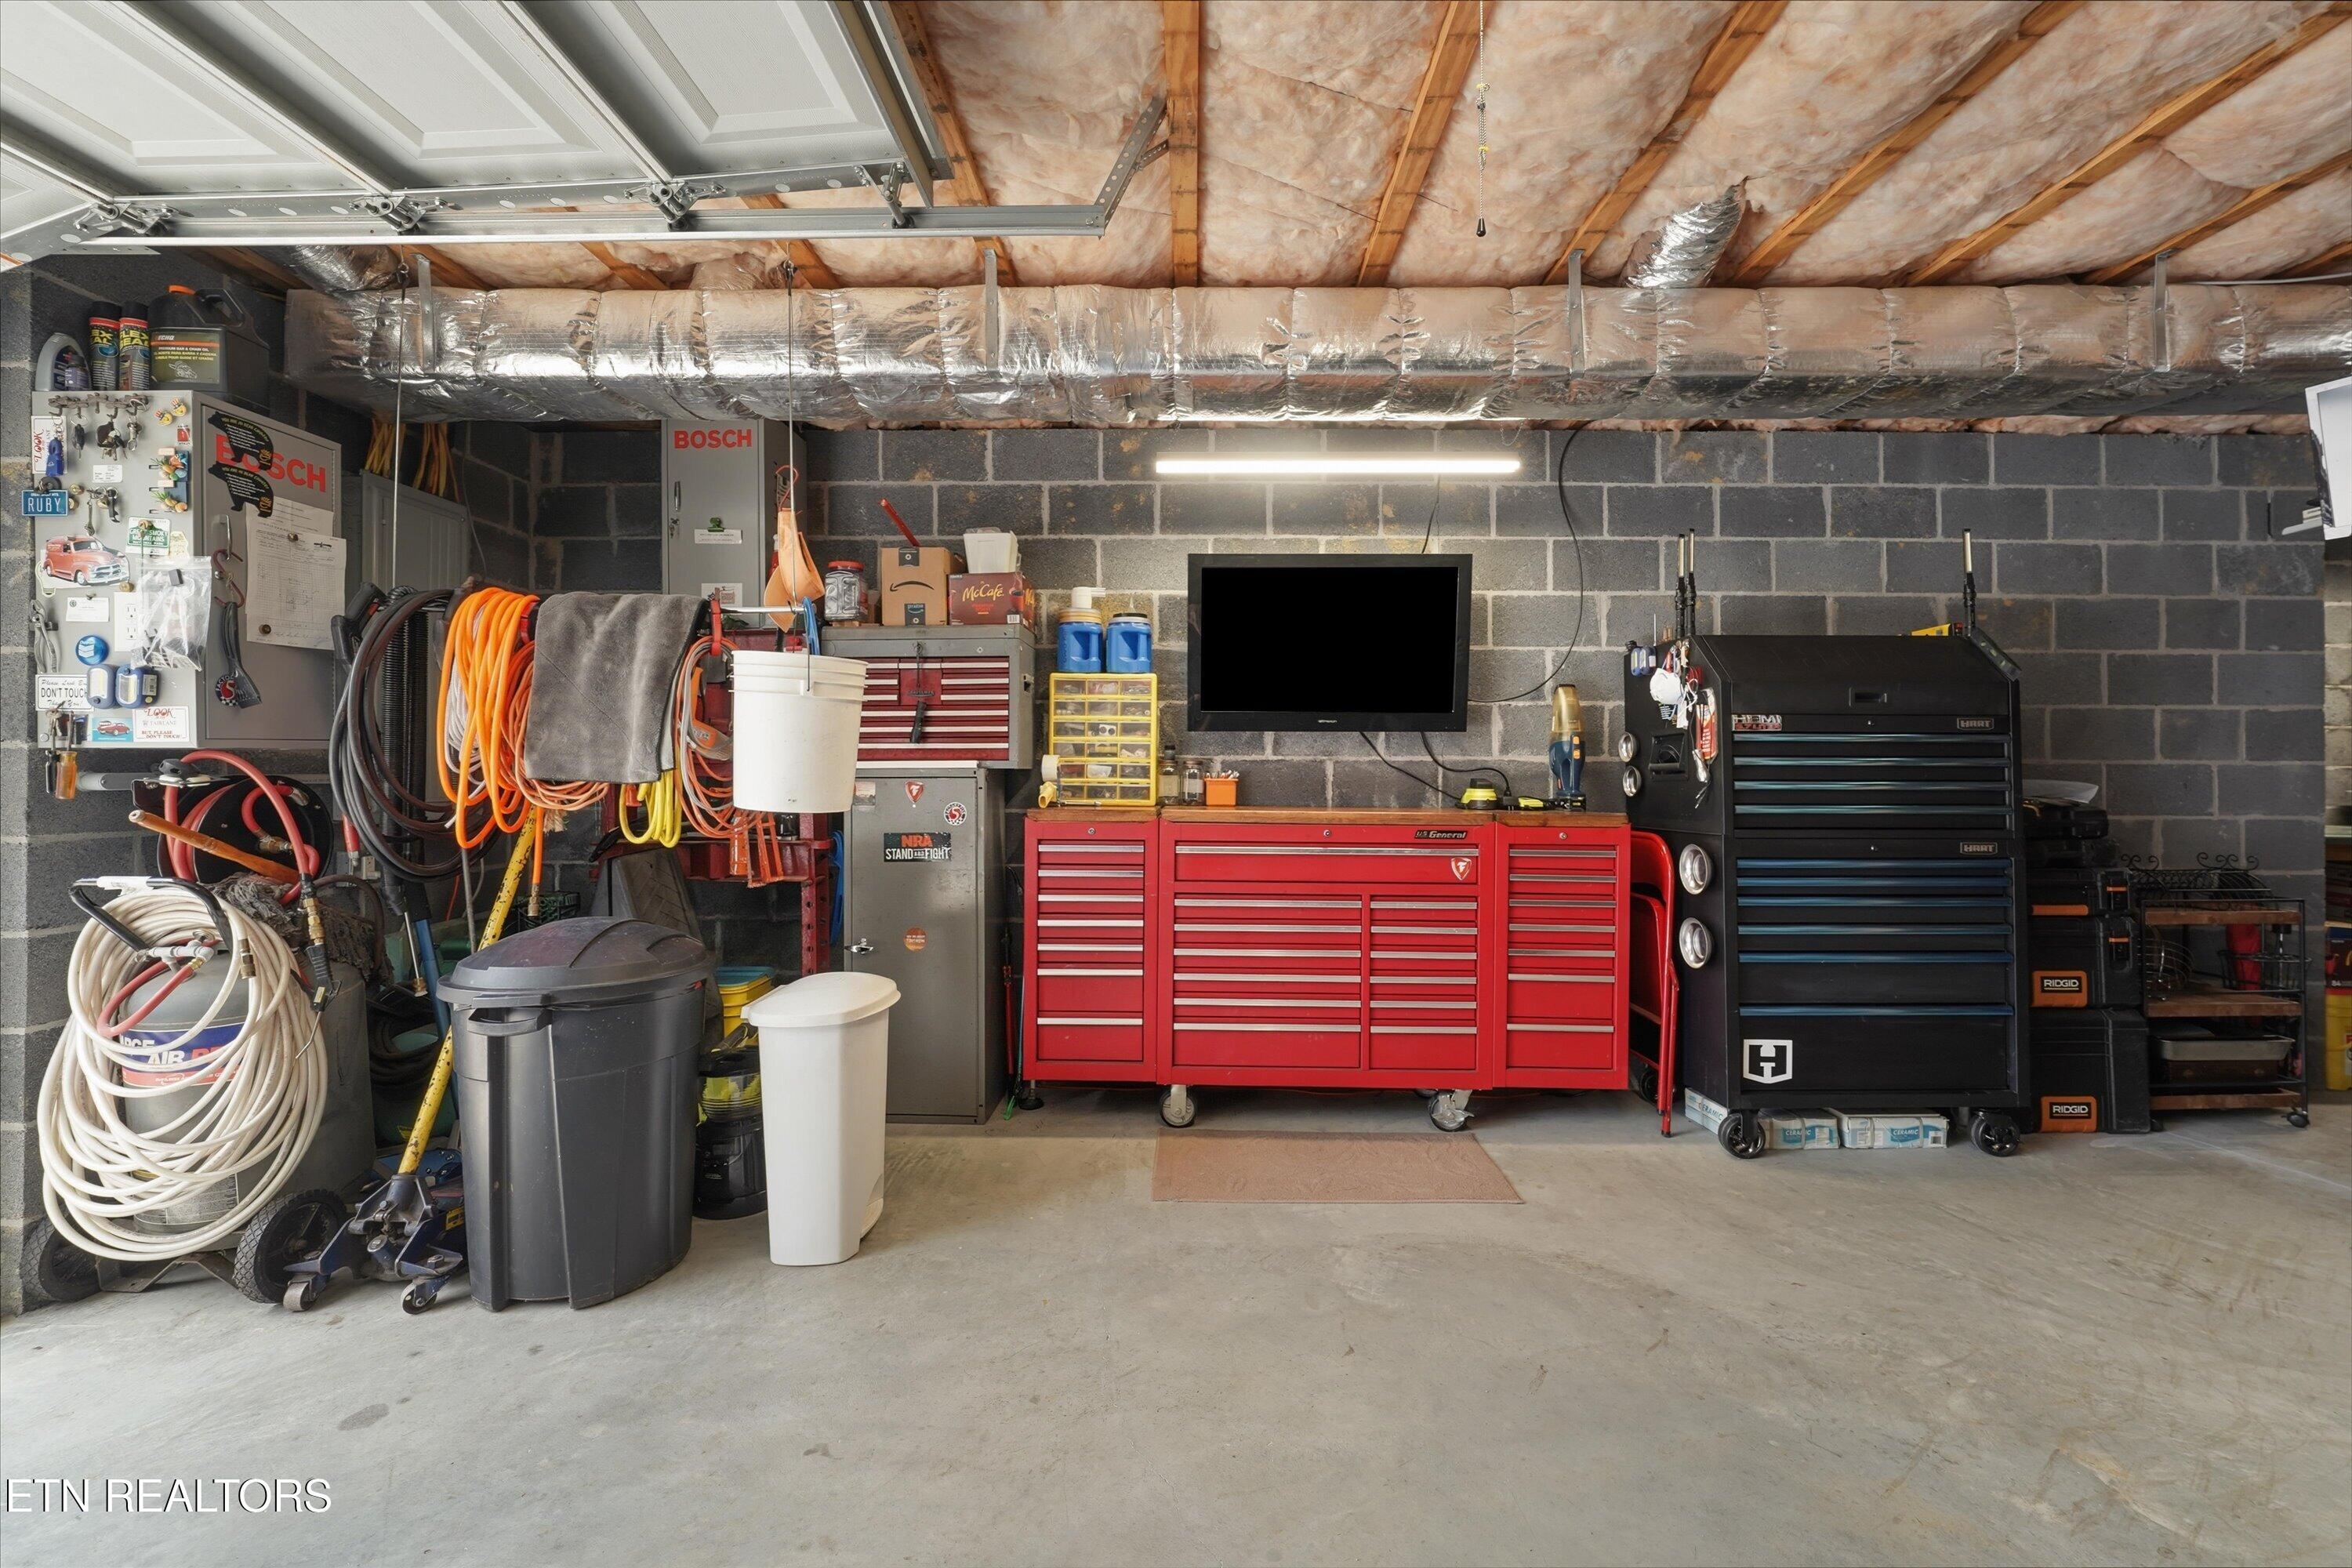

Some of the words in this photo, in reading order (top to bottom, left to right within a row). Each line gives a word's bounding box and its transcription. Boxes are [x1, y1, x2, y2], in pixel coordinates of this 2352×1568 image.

[91, 329, 113, 339] EX
[674, 429, 752, 449] BOSCH
[34, 429, 45, 463] LOOK
[27, 497, 61, 512] RUBY
[962, 583, 1004, 601] McCafé
[42, 688, 62, 697] DON'T
[64, 688, 88, 698] TOUCH
[144, 708, 176, 719] LOOK
[1731, 714, 1782, 724] HEMI
[901, 835, 933, 848] NRA
[885, 848, 913, 860] STAND
[925, 847, 951, 861] FIGHT
[2043, 979, 2079, 988] RIDGID
[147, 1050, 185, 1065] AIR
[2052, 1105, 2089, 1113] RIDGID
